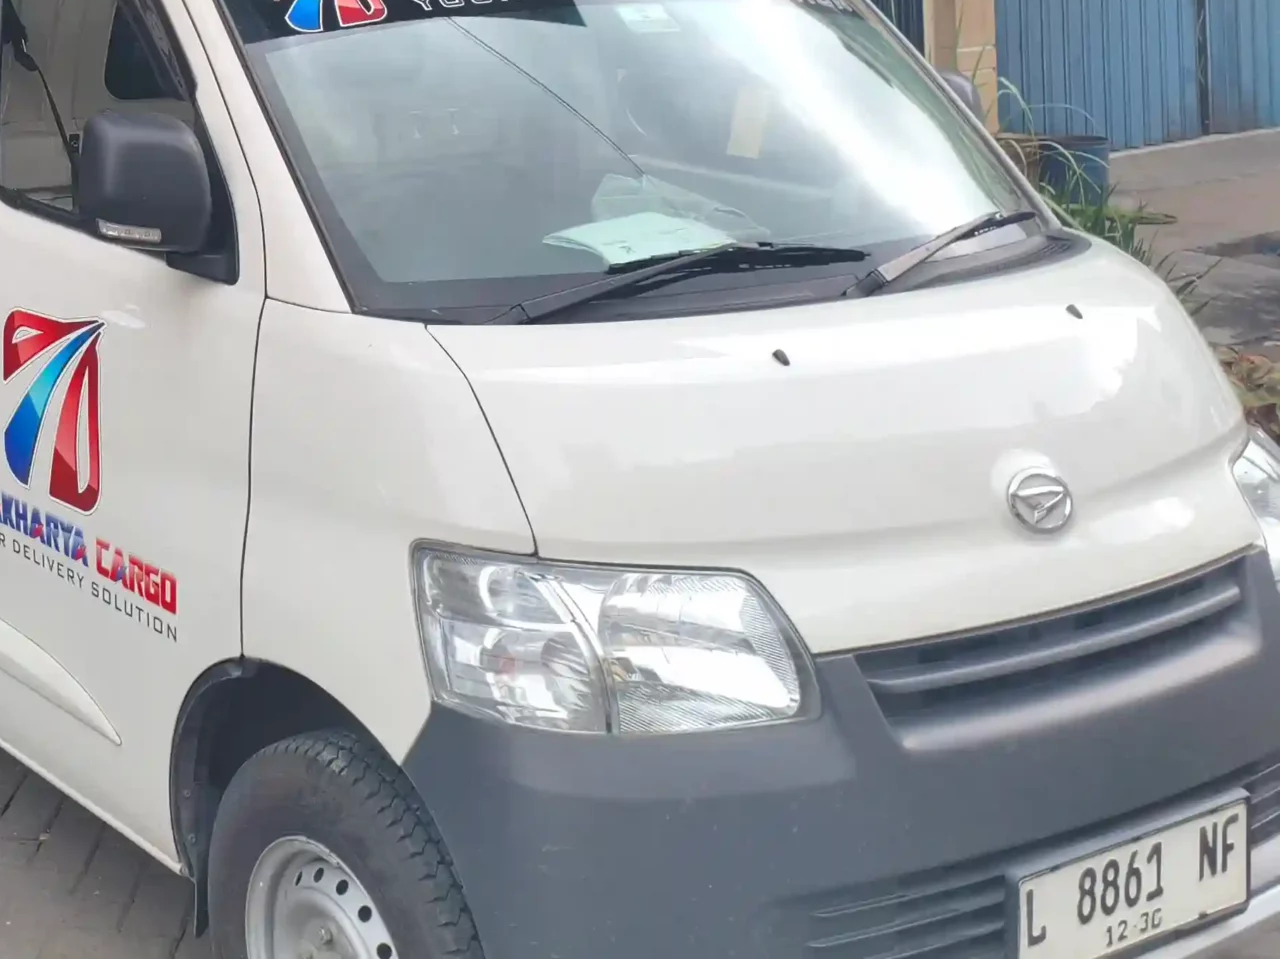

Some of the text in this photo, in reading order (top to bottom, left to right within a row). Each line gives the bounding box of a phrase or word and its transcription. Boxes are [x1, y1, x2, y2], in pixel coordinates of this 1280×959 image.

[12, 538, 85, 590] DELIVERY
[91, 580, 178, 643] SOLUTION
[95, 537, 178, 616] CARGO
[1025, 812, 1239, 947] L 8861 NF
